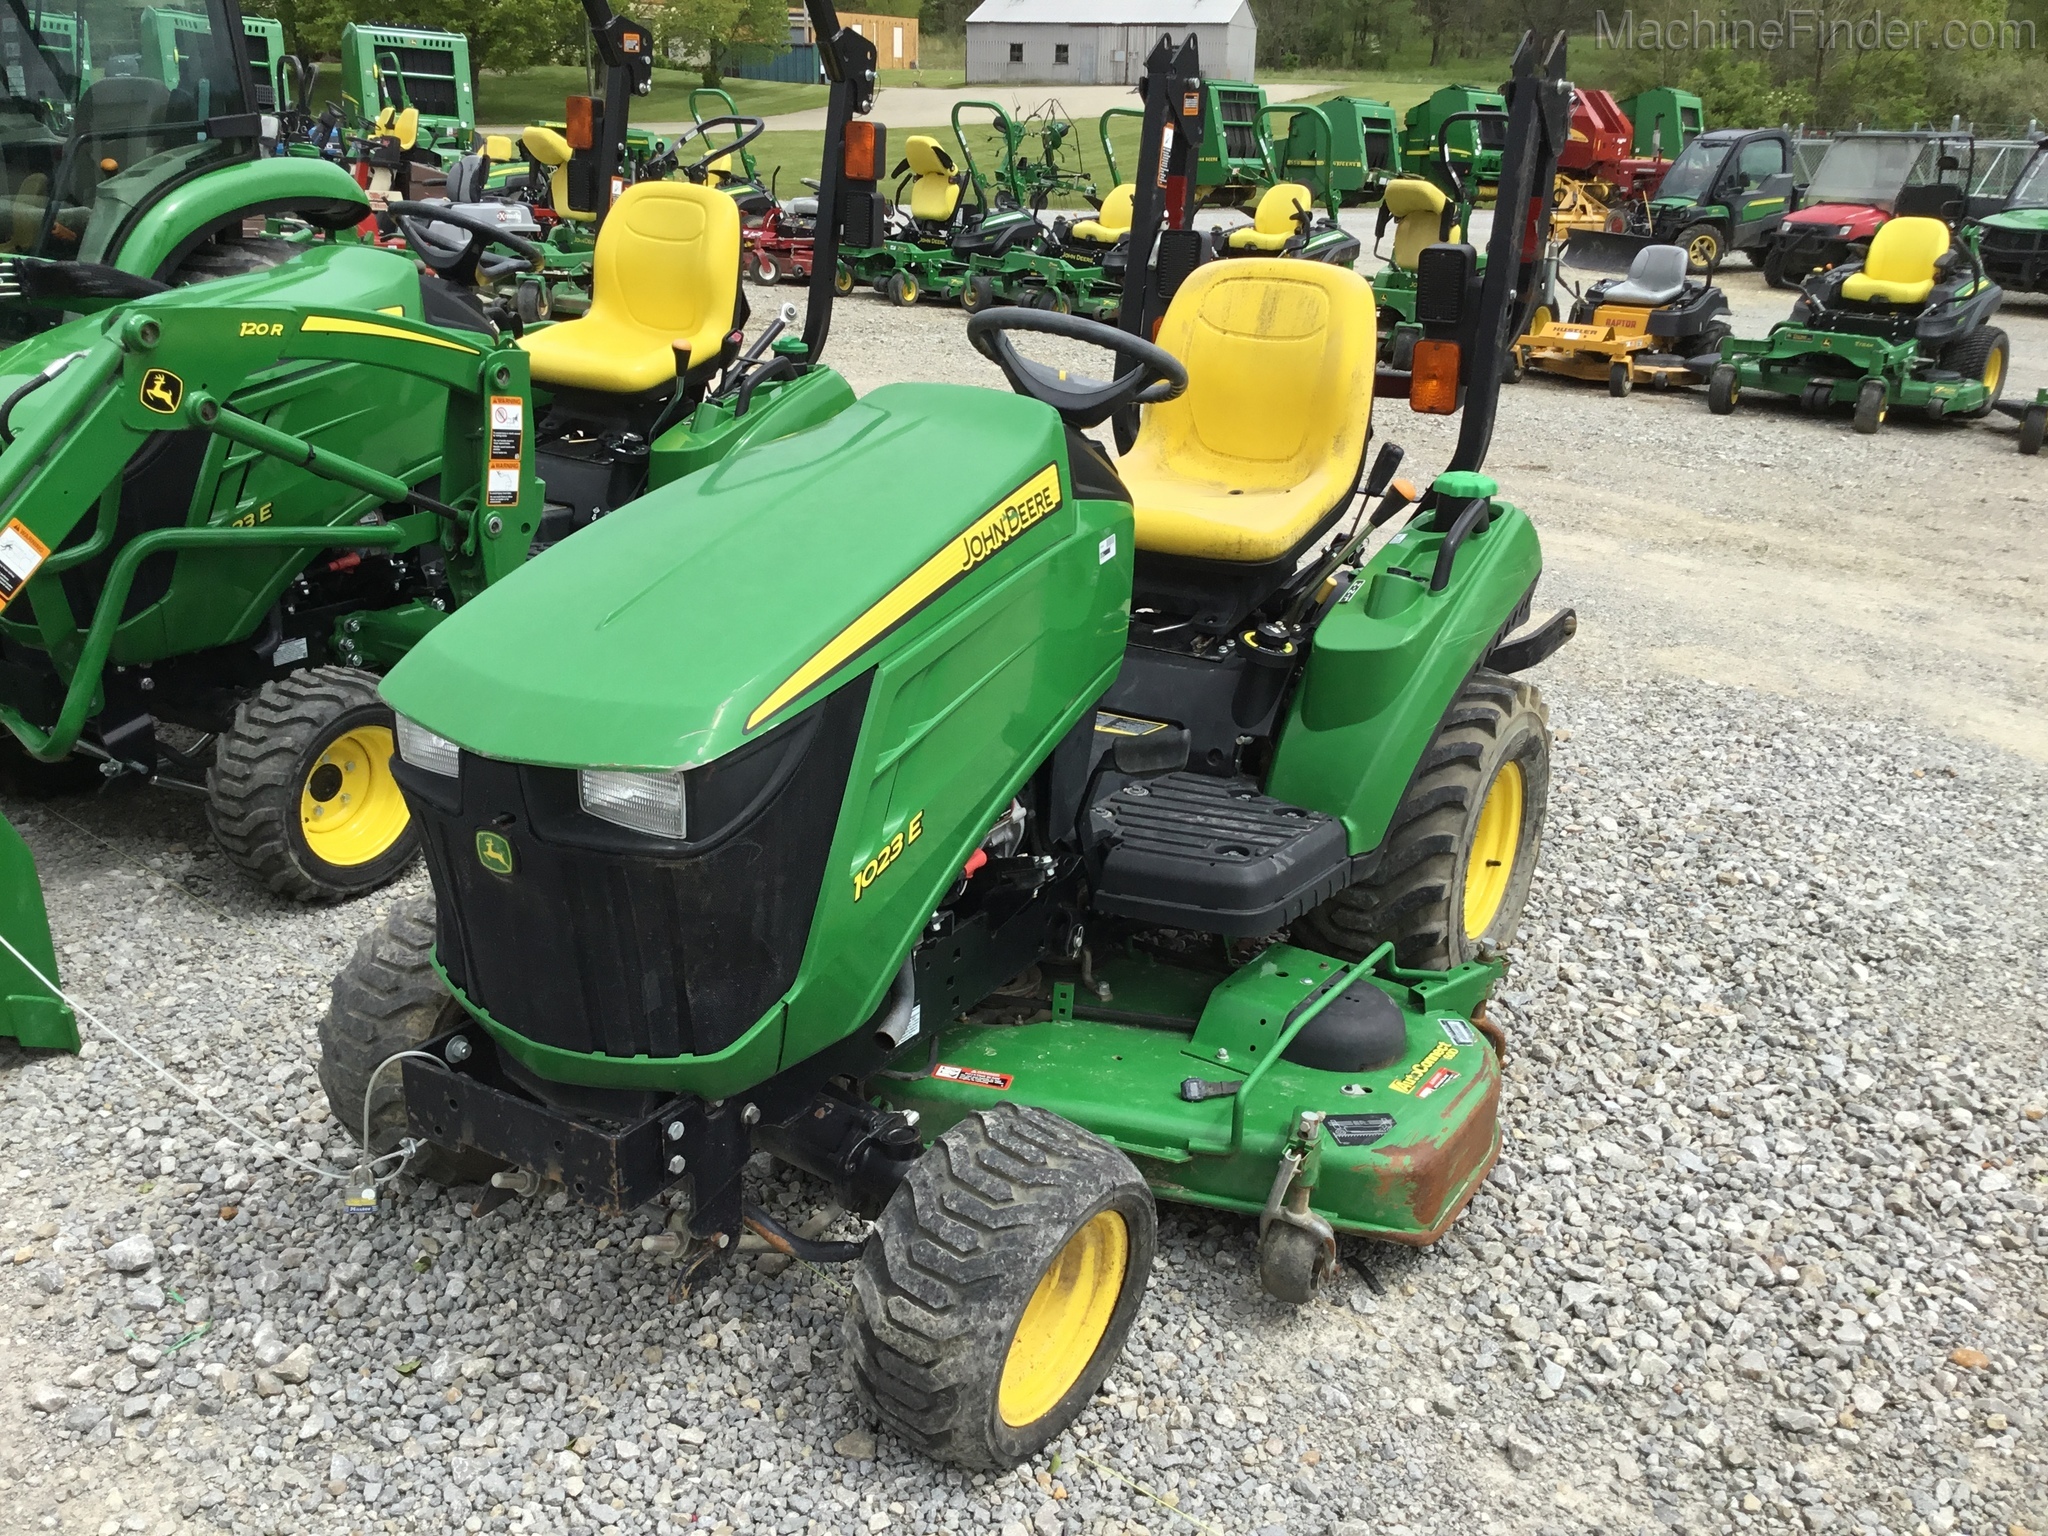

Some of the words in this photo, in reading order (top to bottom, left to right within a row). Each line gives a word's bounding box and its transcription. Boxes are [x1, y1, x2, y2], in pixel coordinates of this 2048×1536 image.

[1076, 255, 1094, 263] DEERE
[240, 322, 270, 337] 120
[270, 323, 284, 337] R
[1553, 326, 1598, 335] HUSTLER
[1605, 318, 1637, 329] RAPTOR
[260, 502, 272, 523] E
[963, 518, 1007, 568] JOHN
[1004, 486, 1054, 534] DEERE
[854, 832, 904, 902] 1023
[908, 810, 924, 845] E
[1394, 1041, 1452, 1093] AutoConnect
